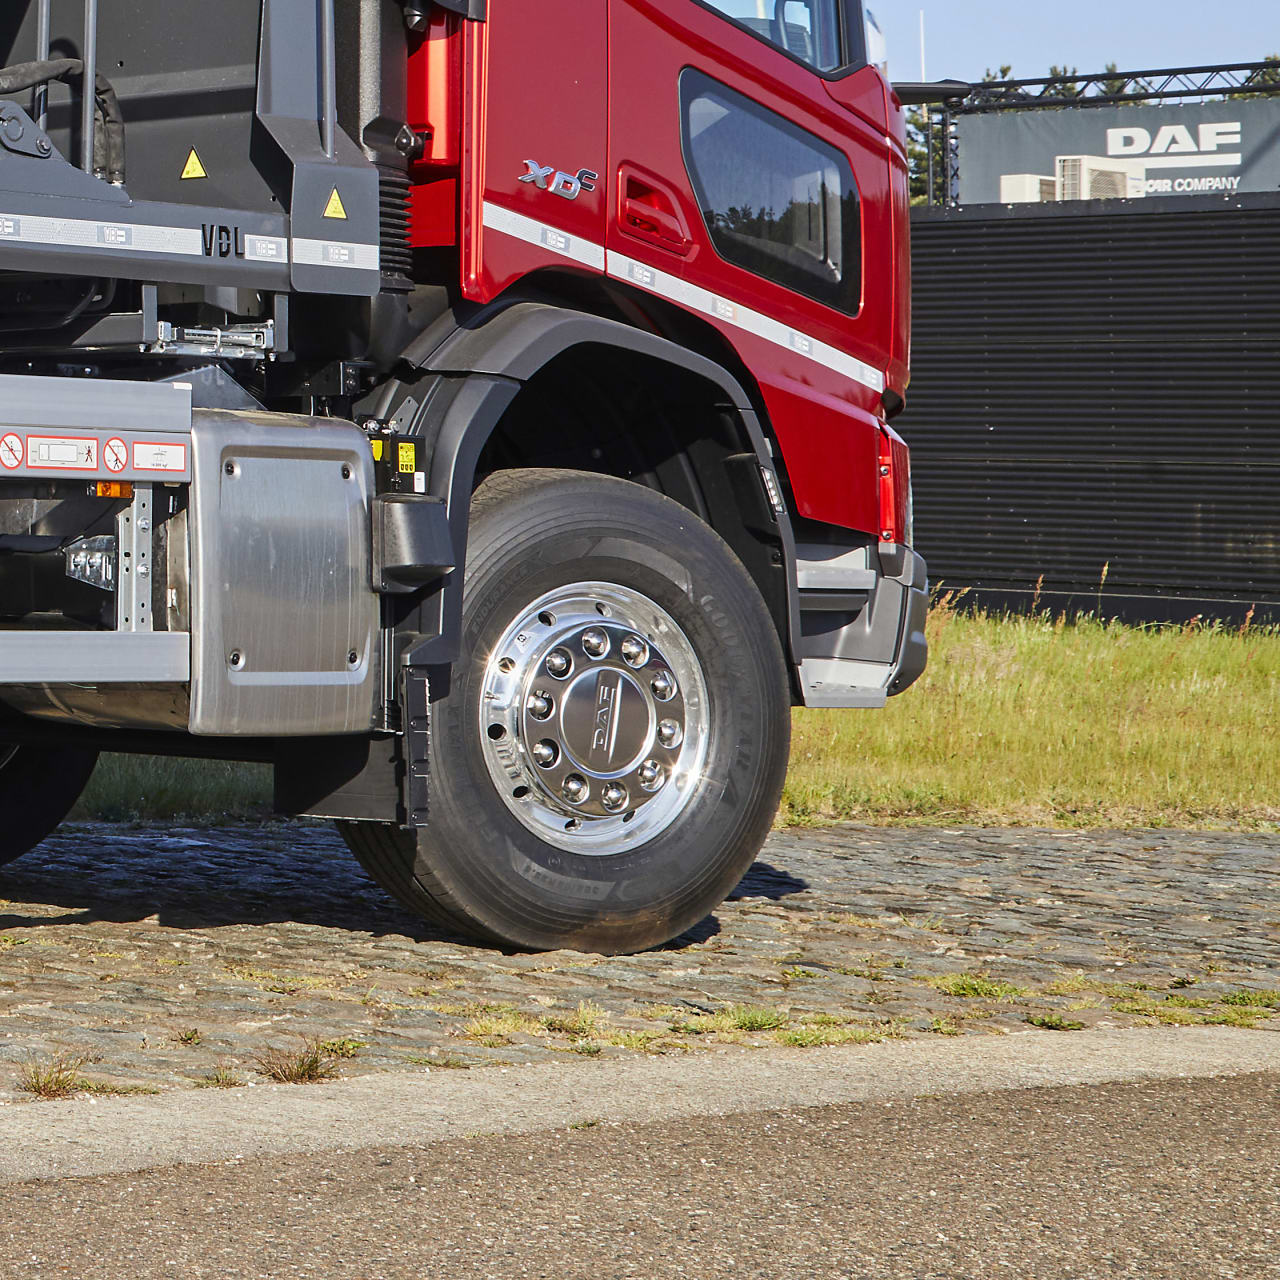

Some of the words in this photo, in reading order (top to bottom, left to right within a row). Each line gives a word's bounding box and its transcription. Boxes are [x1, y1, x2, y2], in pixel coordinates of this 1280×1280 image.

[1106, 122, 1241, 156] DAF
[1174, 176, 1241, 191] COMPANY
[201, 223, 245, 258] VDL
[592, 686, 616, 752] DAF
